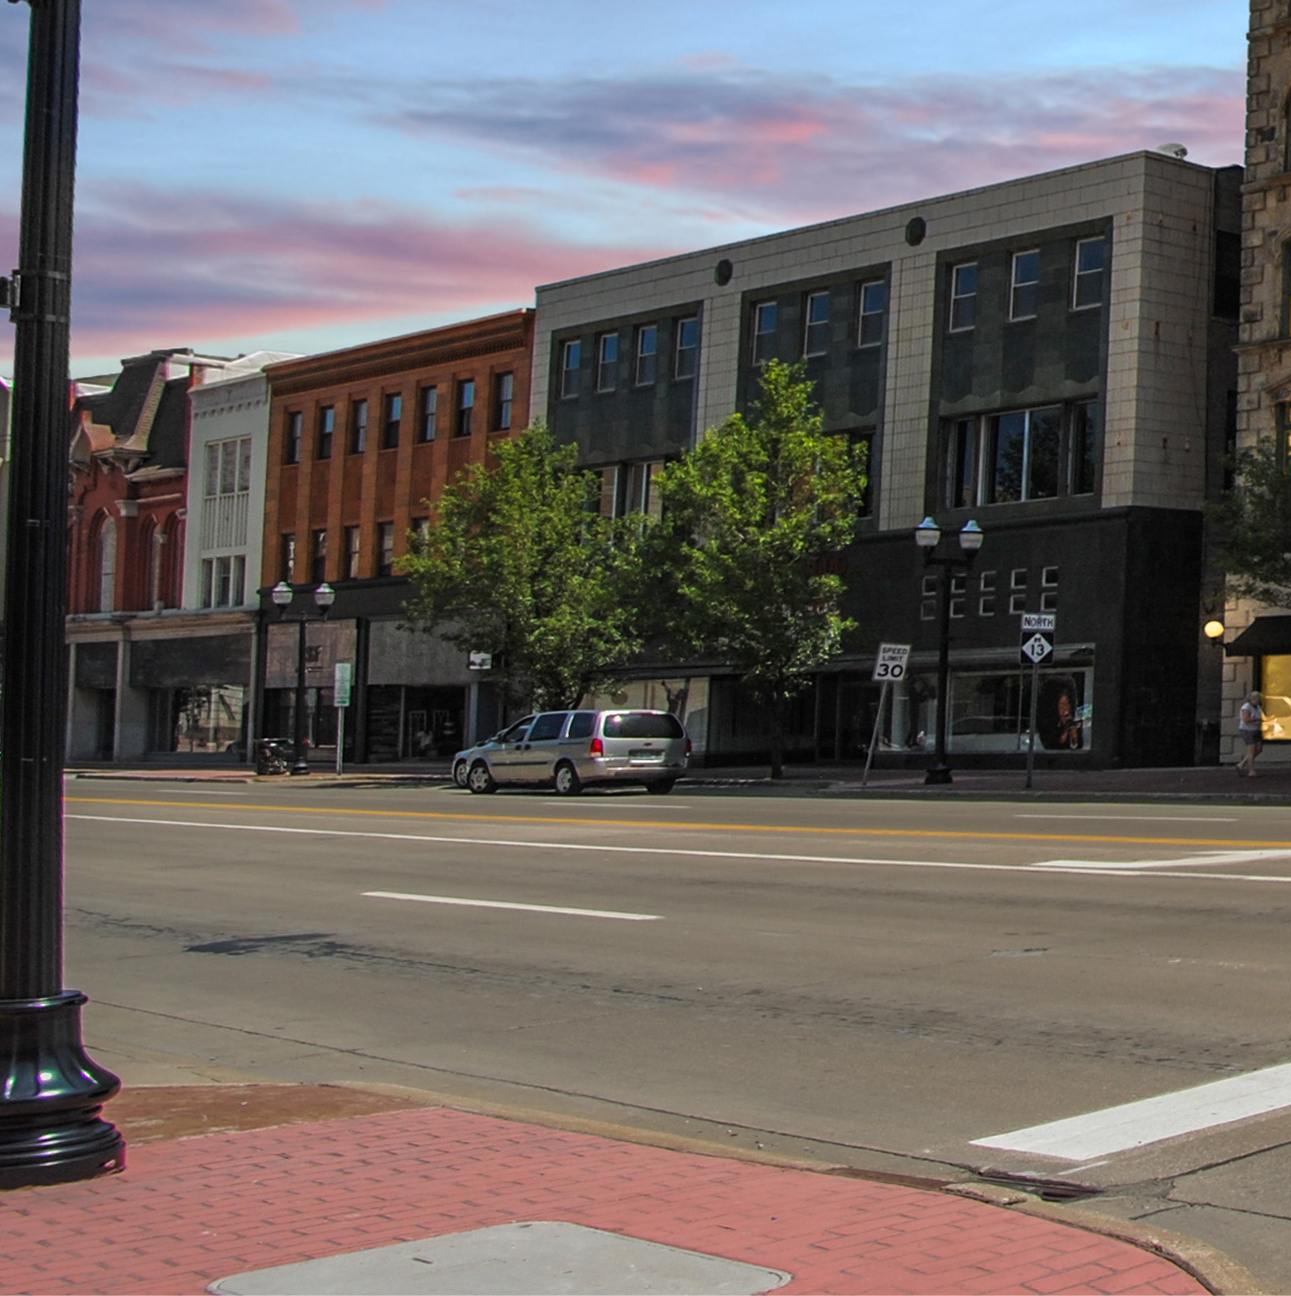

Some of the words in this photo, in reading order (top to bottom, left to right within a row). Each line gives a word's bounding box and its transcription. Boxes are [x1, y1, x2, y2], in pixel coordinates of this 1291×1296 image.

[1024, 616, 1054, 627] NORTH
[882, 647, 908, 655] SPEED
[1031, 644, 1045, 656] 13
[877, 663, 903, 678] 30
